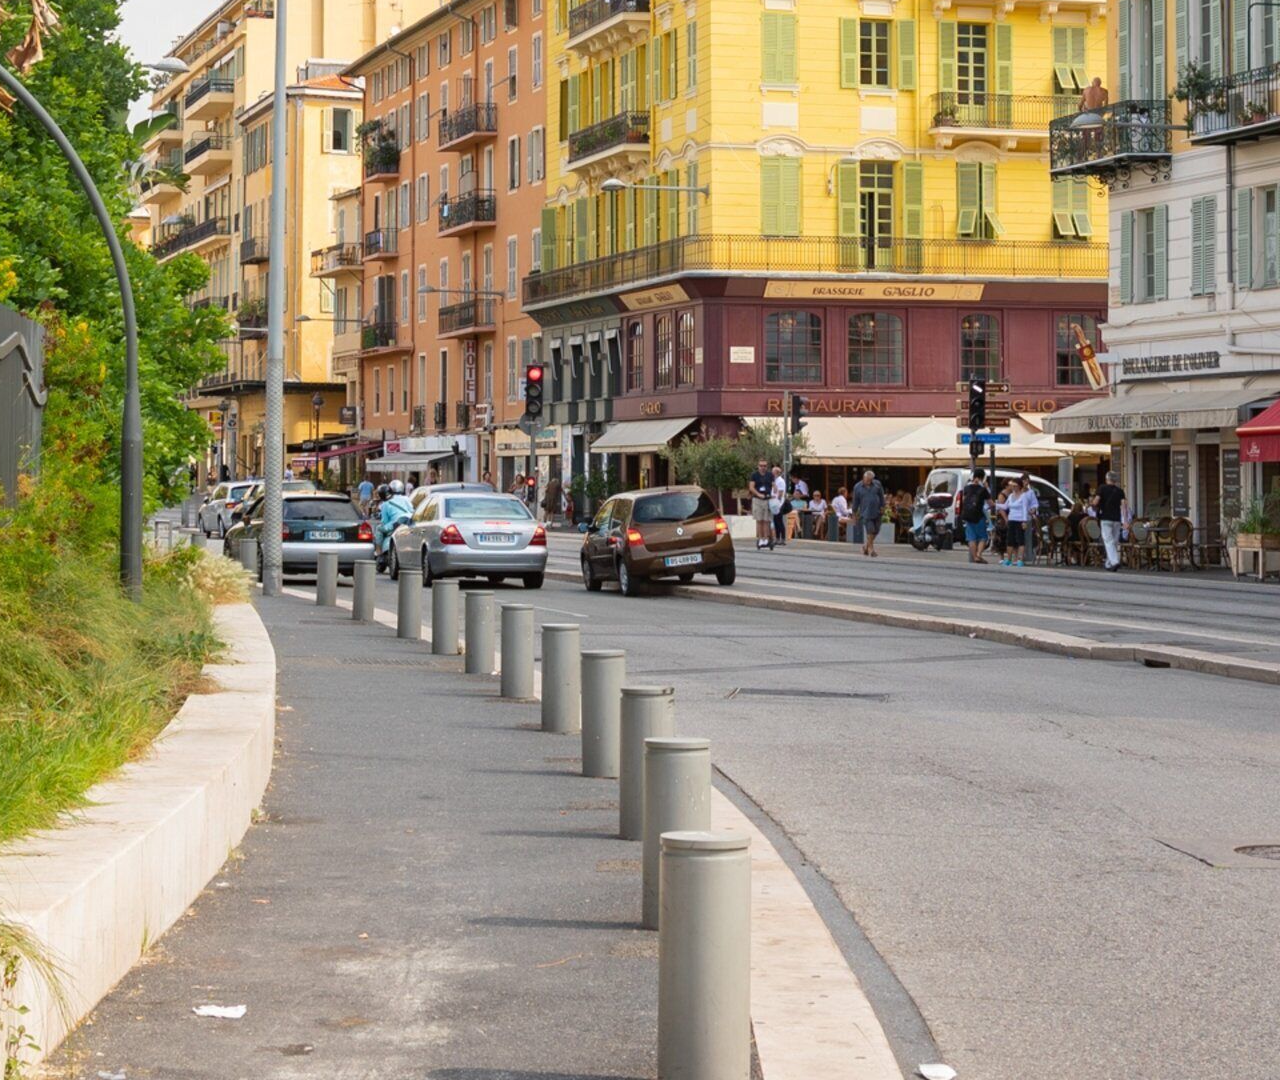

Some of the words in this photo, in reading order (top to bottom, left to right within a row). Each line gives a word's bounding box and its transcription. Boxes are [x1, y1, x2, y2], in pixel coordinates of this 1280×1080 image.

[812, 287, 865, 297] BRASSERIE
[882, 287, 935, 297] GAGLIO
[466, 341, 475, 404] HOTEL
[1122, 355, 1170, 375] BOULANGERIE
[767, 398, 893, 412] RETAURANT
[1087, 415, 1132, 430] BOULANGERIE
